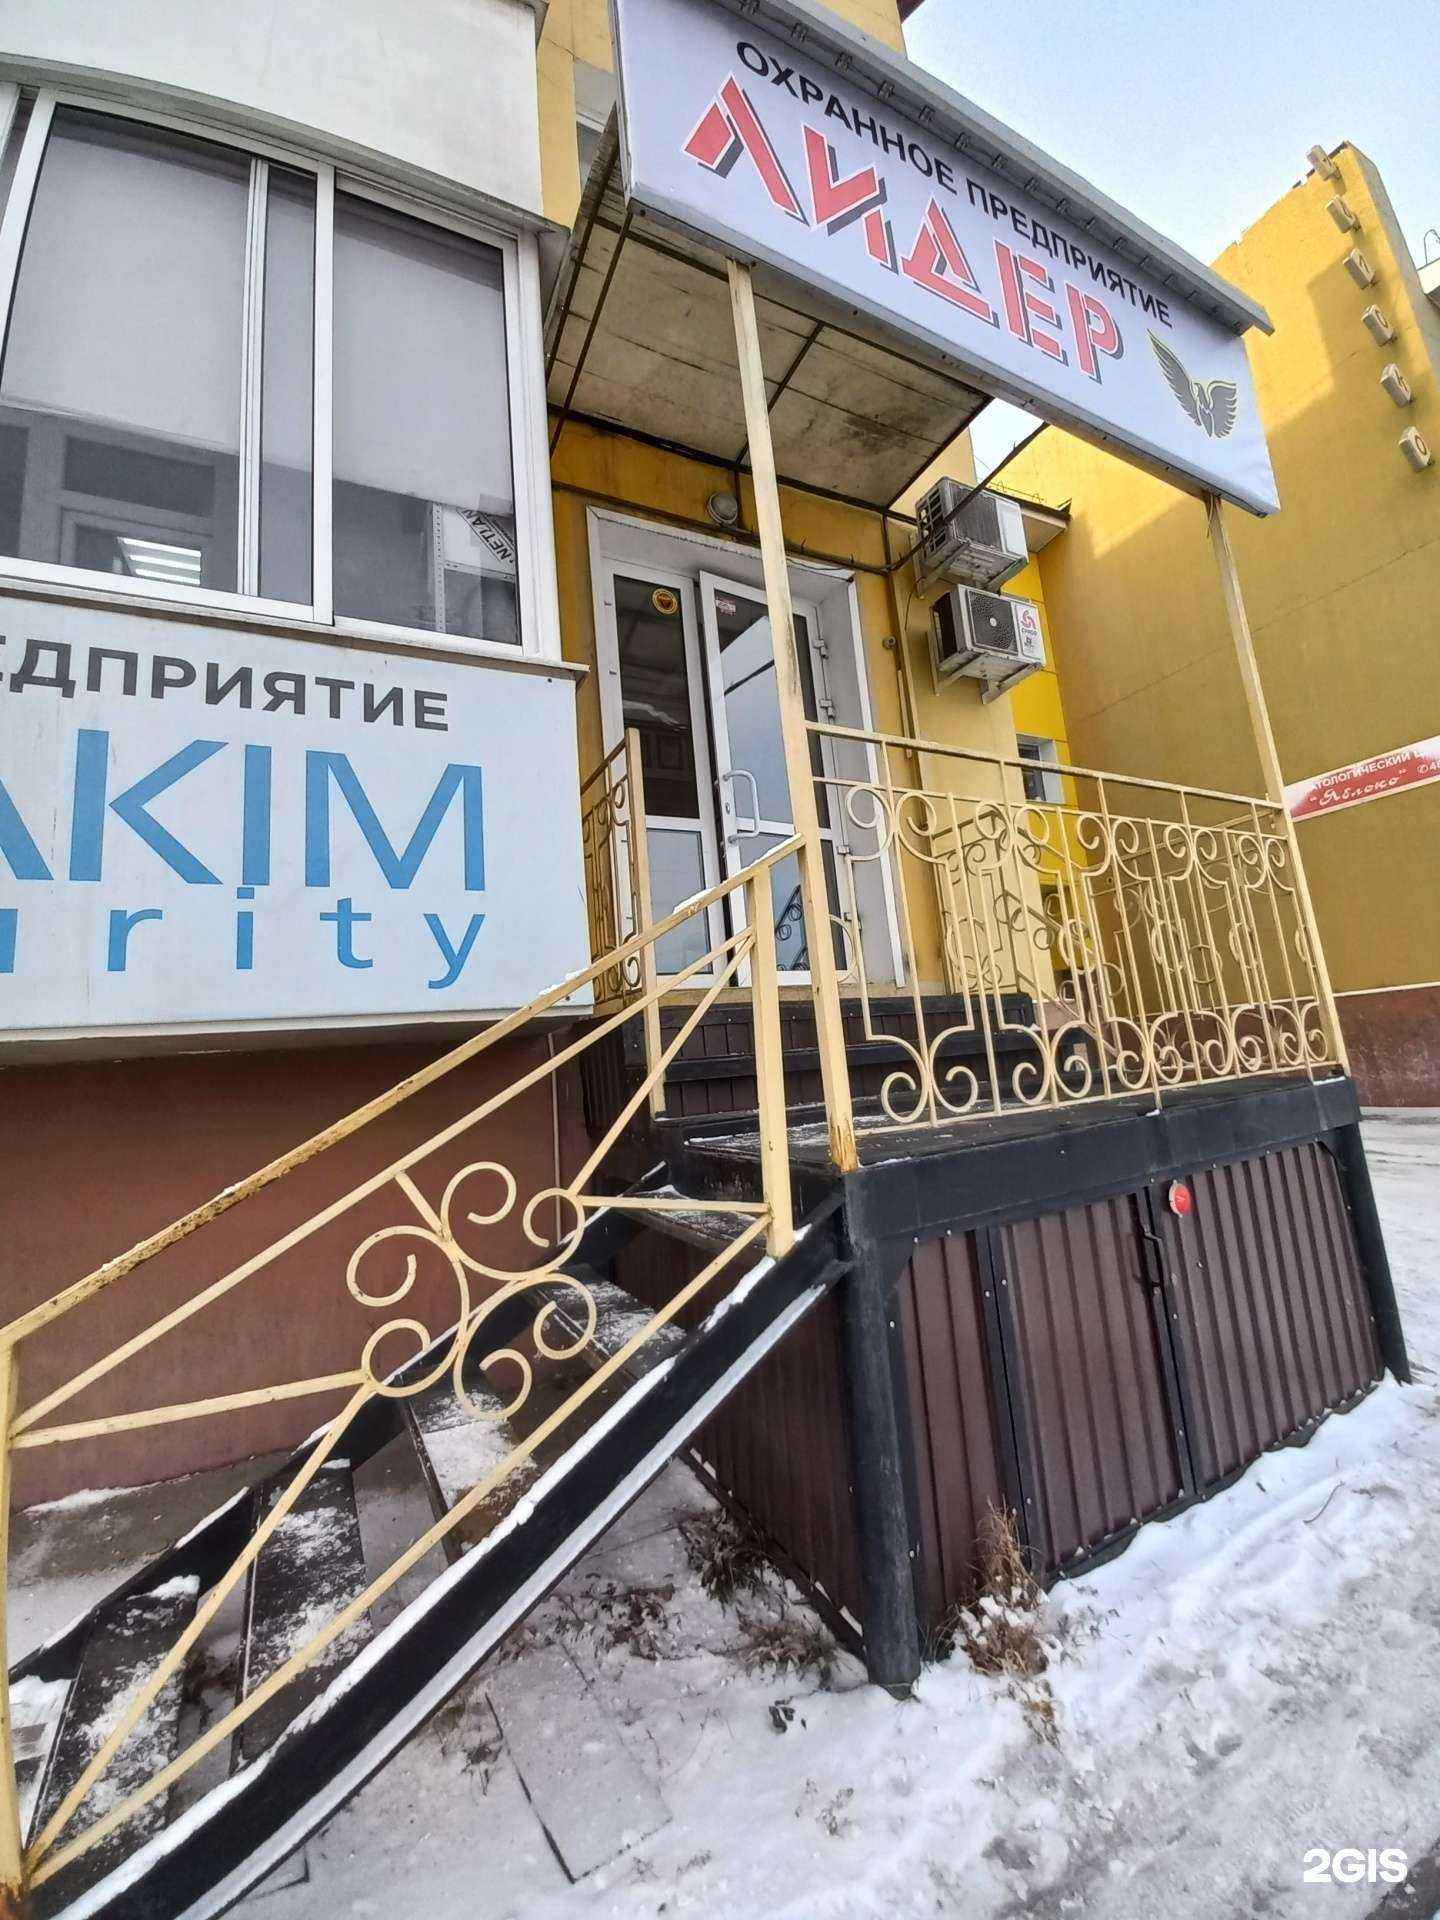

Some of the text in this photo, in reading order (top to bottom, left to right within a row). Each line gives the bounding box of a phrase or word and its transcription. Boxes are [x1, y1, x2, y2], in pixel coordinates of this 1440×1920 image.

[681, 72, 1126, 383] ЛИДЕР
[736, 41, 1174, 329] ОХРАННОЕ ПРЕДПРИЯТИЕ
[0, 634, 449, 731] ДПРИЯТИЕ
